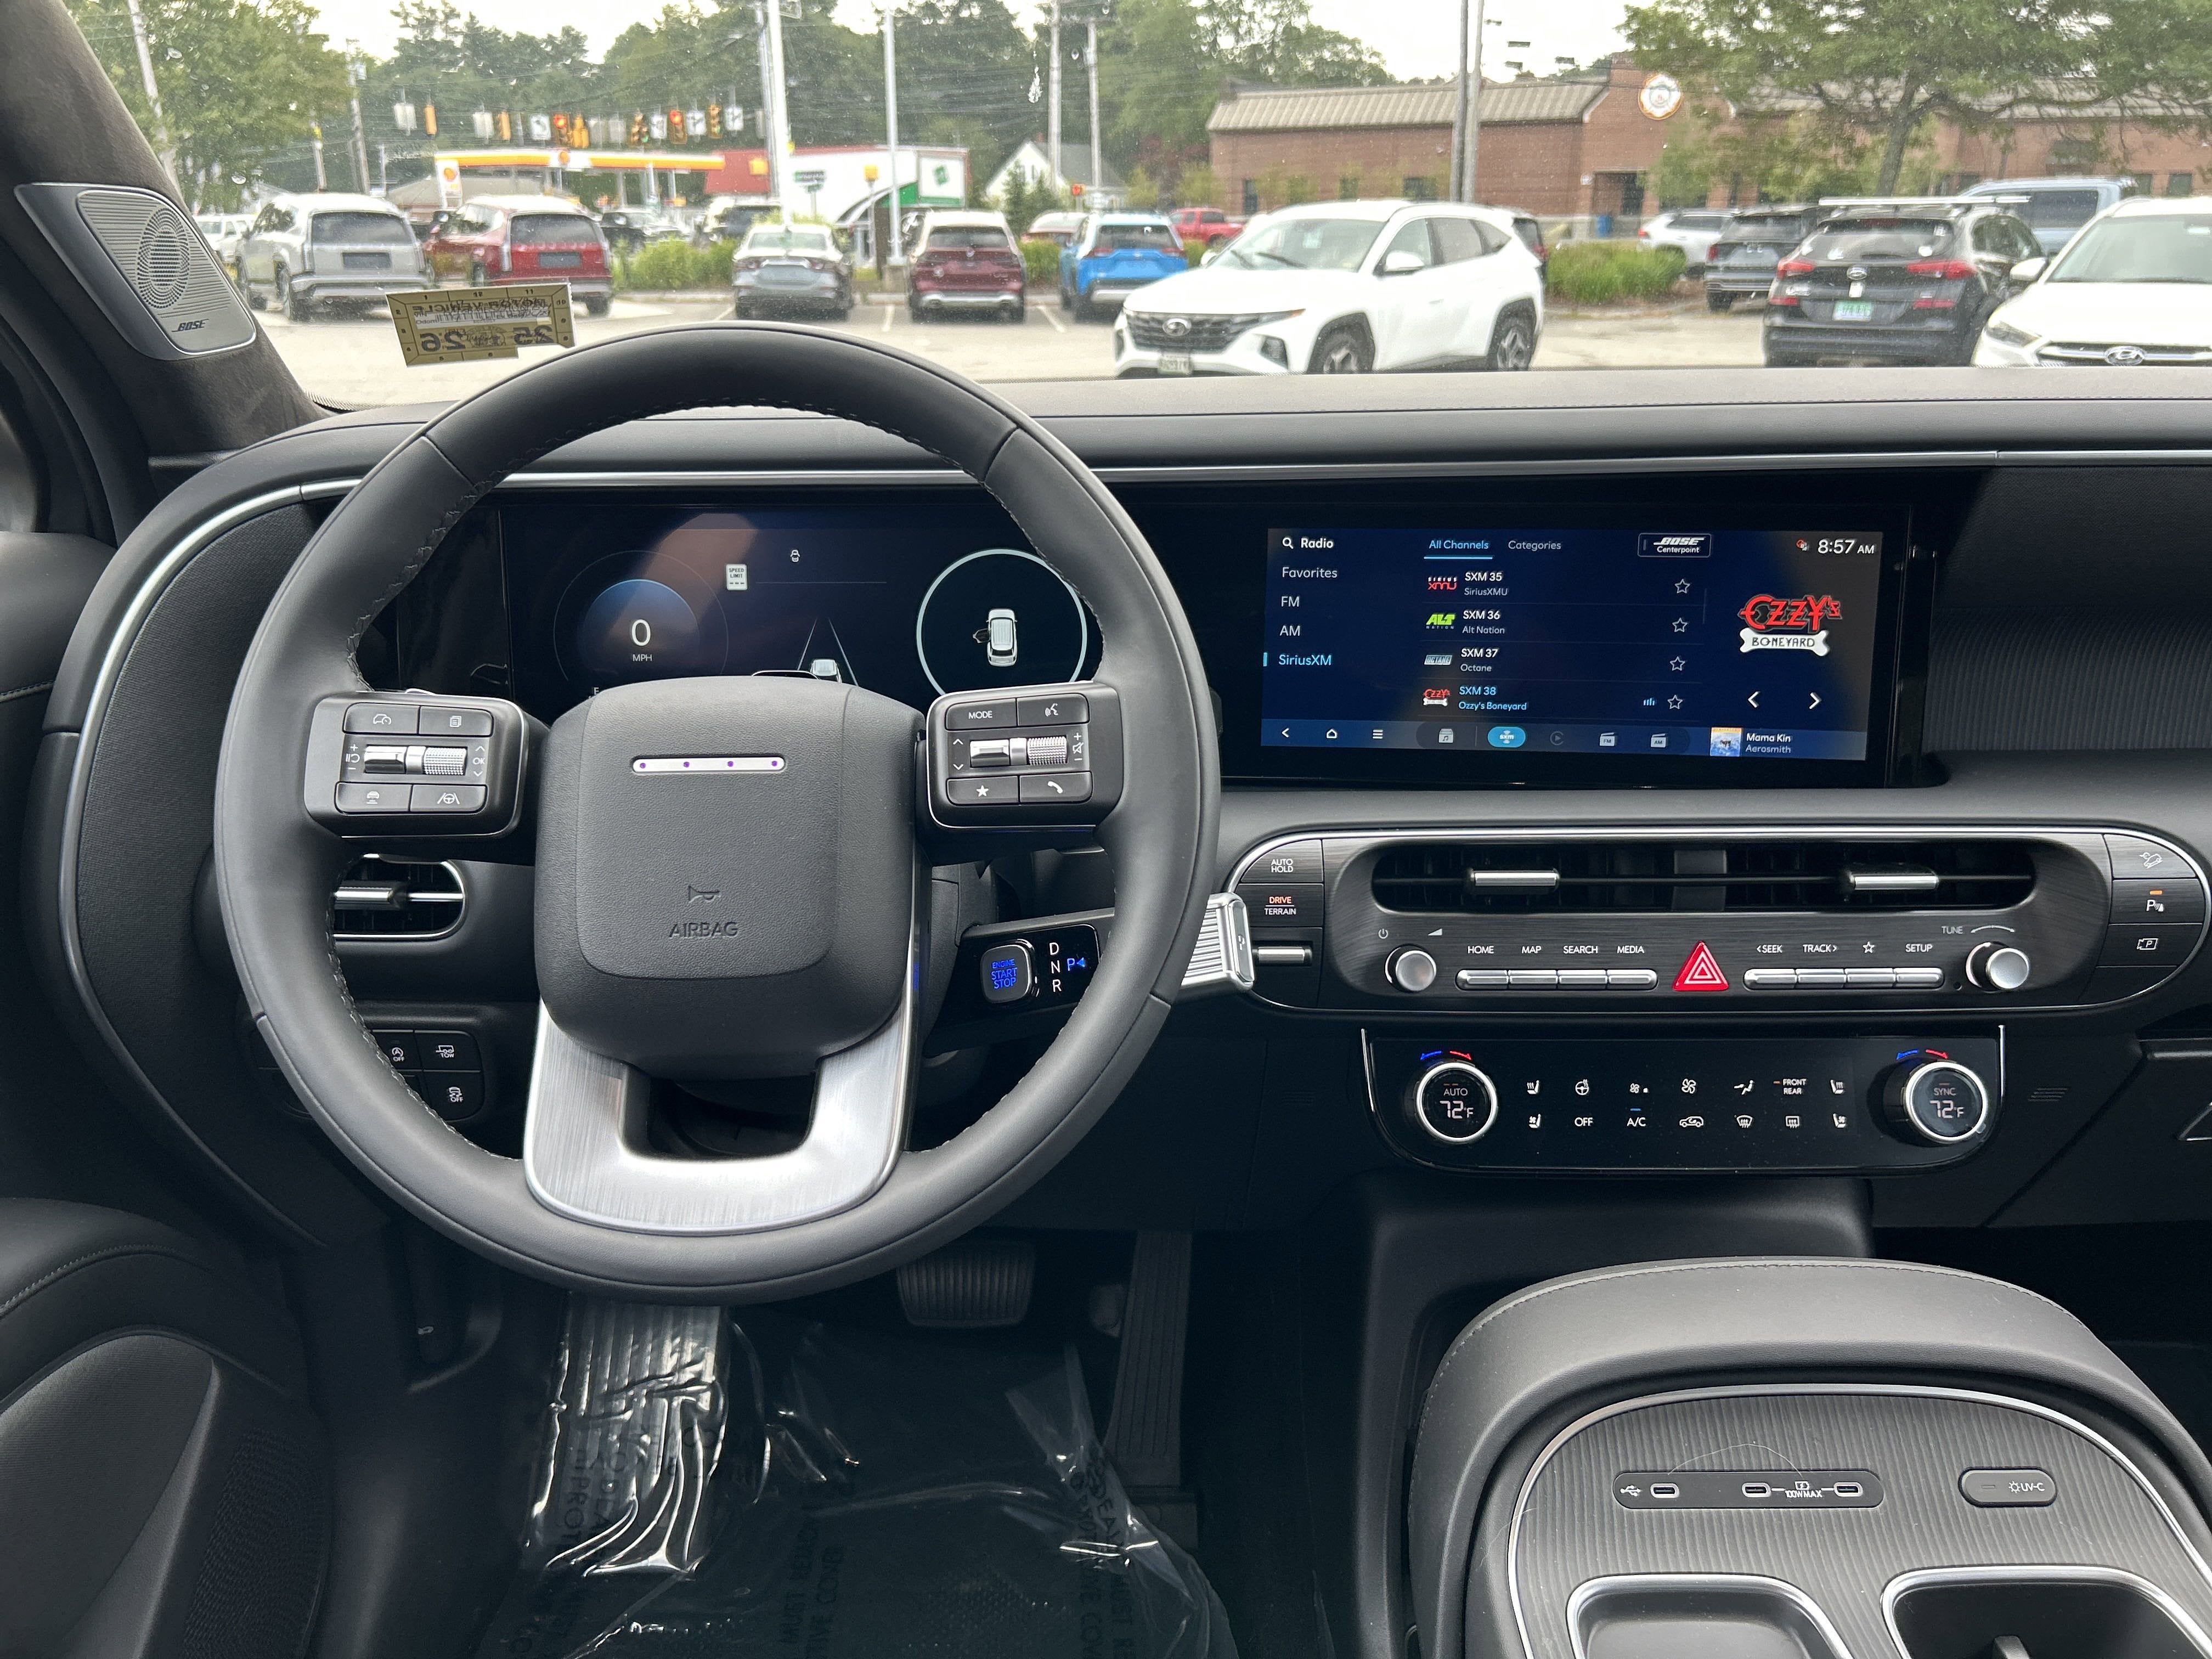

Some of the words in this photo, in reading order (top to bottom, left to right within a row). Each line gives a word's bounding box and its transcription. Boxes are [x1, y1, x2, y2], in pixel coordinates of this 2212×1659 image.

[171, 319, 209, 332] BOSE
[1301, 538, 1334, 549] Radio
[1429, 540, 1441, 549] All
[1443, 540, 1489, 549] Channels
[1508, 540, 1561, 551] Categories
[1654, 537, 1705, 545] BOSE
[1657, 546, 1700, 554] Centerpoint
[1818, 539, 1856, 554] 8:57
[1857, 544, 1875, 554] AM
[1282, 567, 1338, 578] Favorites
[1465, 572, 1487, 581] SXM
[1489, 572, 1503, 581] 35
[1464, 588, 1508, 596] SiriusXMU
[1281, 596, 1300, 607] FM
[1426, 613, 1455, 625] ALT
[1463, 610, 1485, 619] SXM
[1487, 610, 1500, 619] 36
[631, 619, 651, 646] 0
[1279, 625, 1300, 636] AM
[1752, 636, 1815, 647] BONEYARD
[633, 654, 653, 662] MPH
[1461, 648, 1483, 657] SXM
[1486, 648, 1499, 658] 37
[1278, 654, 1331, 665] SiriusXM
[1459, 686, 1481, 695] SXM
[1483, 686, 1496, 695] 38
[1458, 702, 1485, 710] Ozzy's
[1486, 702, 1527, 711] Boneyard
[968, 710, 993, 719] MODE
[1747, 733, 1775, 742] Mama
[1777, 733, 1792, 742] Kin
[1746, 744, 1791, 754] Aerosmith
[1271, 865, 1294, 873] HOLD
[1268, 896, 1293, 904] DRIVE
[669, 921, 738, 939] AIRBAG
[1942, 926, 1963, 934] TUNE
[1049, 942, 1059, 955] D
[1468, 945, 1494, 955] HOME
[1521, 945, 1542, 955] MAP
[1563, 945, 1599, 955] SEARCH
[1617, 945, 1645, 955] MEDIA
[1905, 944, 1933, 953] SETUP
[992, 958, 1015, 969] ENGINE
[1051, 960, 1060, 974] N
[1066, 958, 1075, 971] P
[991, 967, 1018, 980] START
[994, 977, 1016, 989] STOP
[1052, 979, 1062, 992] R
[1444, 1088, 1468, 1096] AUTO
[1934, 1087, 1956, 1096] SYNC
[1575, 1117, 1593, 1127] OFF
[1627, 1116, 1646, 1127] A/C
[2021, 1482, 2045, 1492] UV-C
